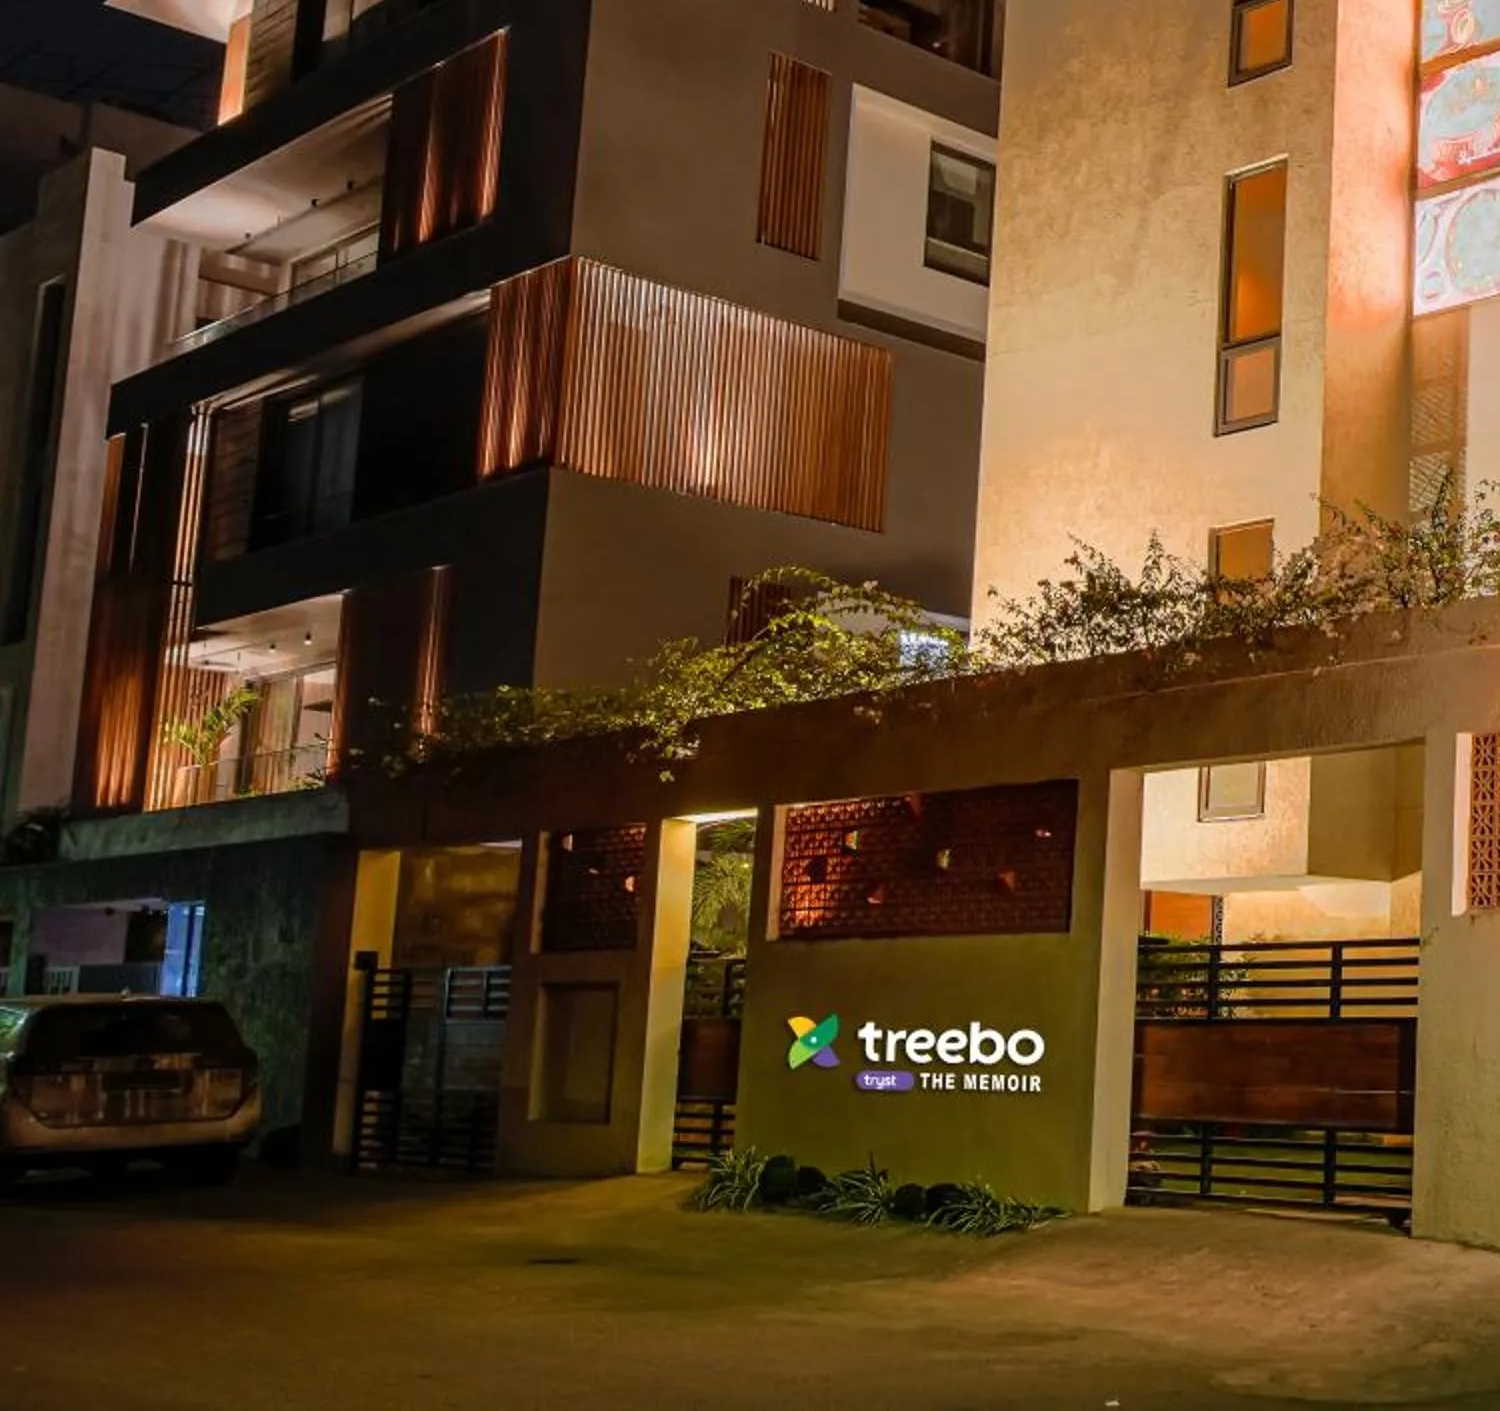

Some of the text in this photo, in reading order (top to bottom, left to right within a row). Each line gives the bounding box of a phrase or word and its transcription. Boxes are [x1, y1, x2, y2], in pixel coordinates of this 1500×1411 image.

[857, 1021, 1045, 1065] treebo
[864, 1072, 1041, 1092] tryst THE MEMOIR
